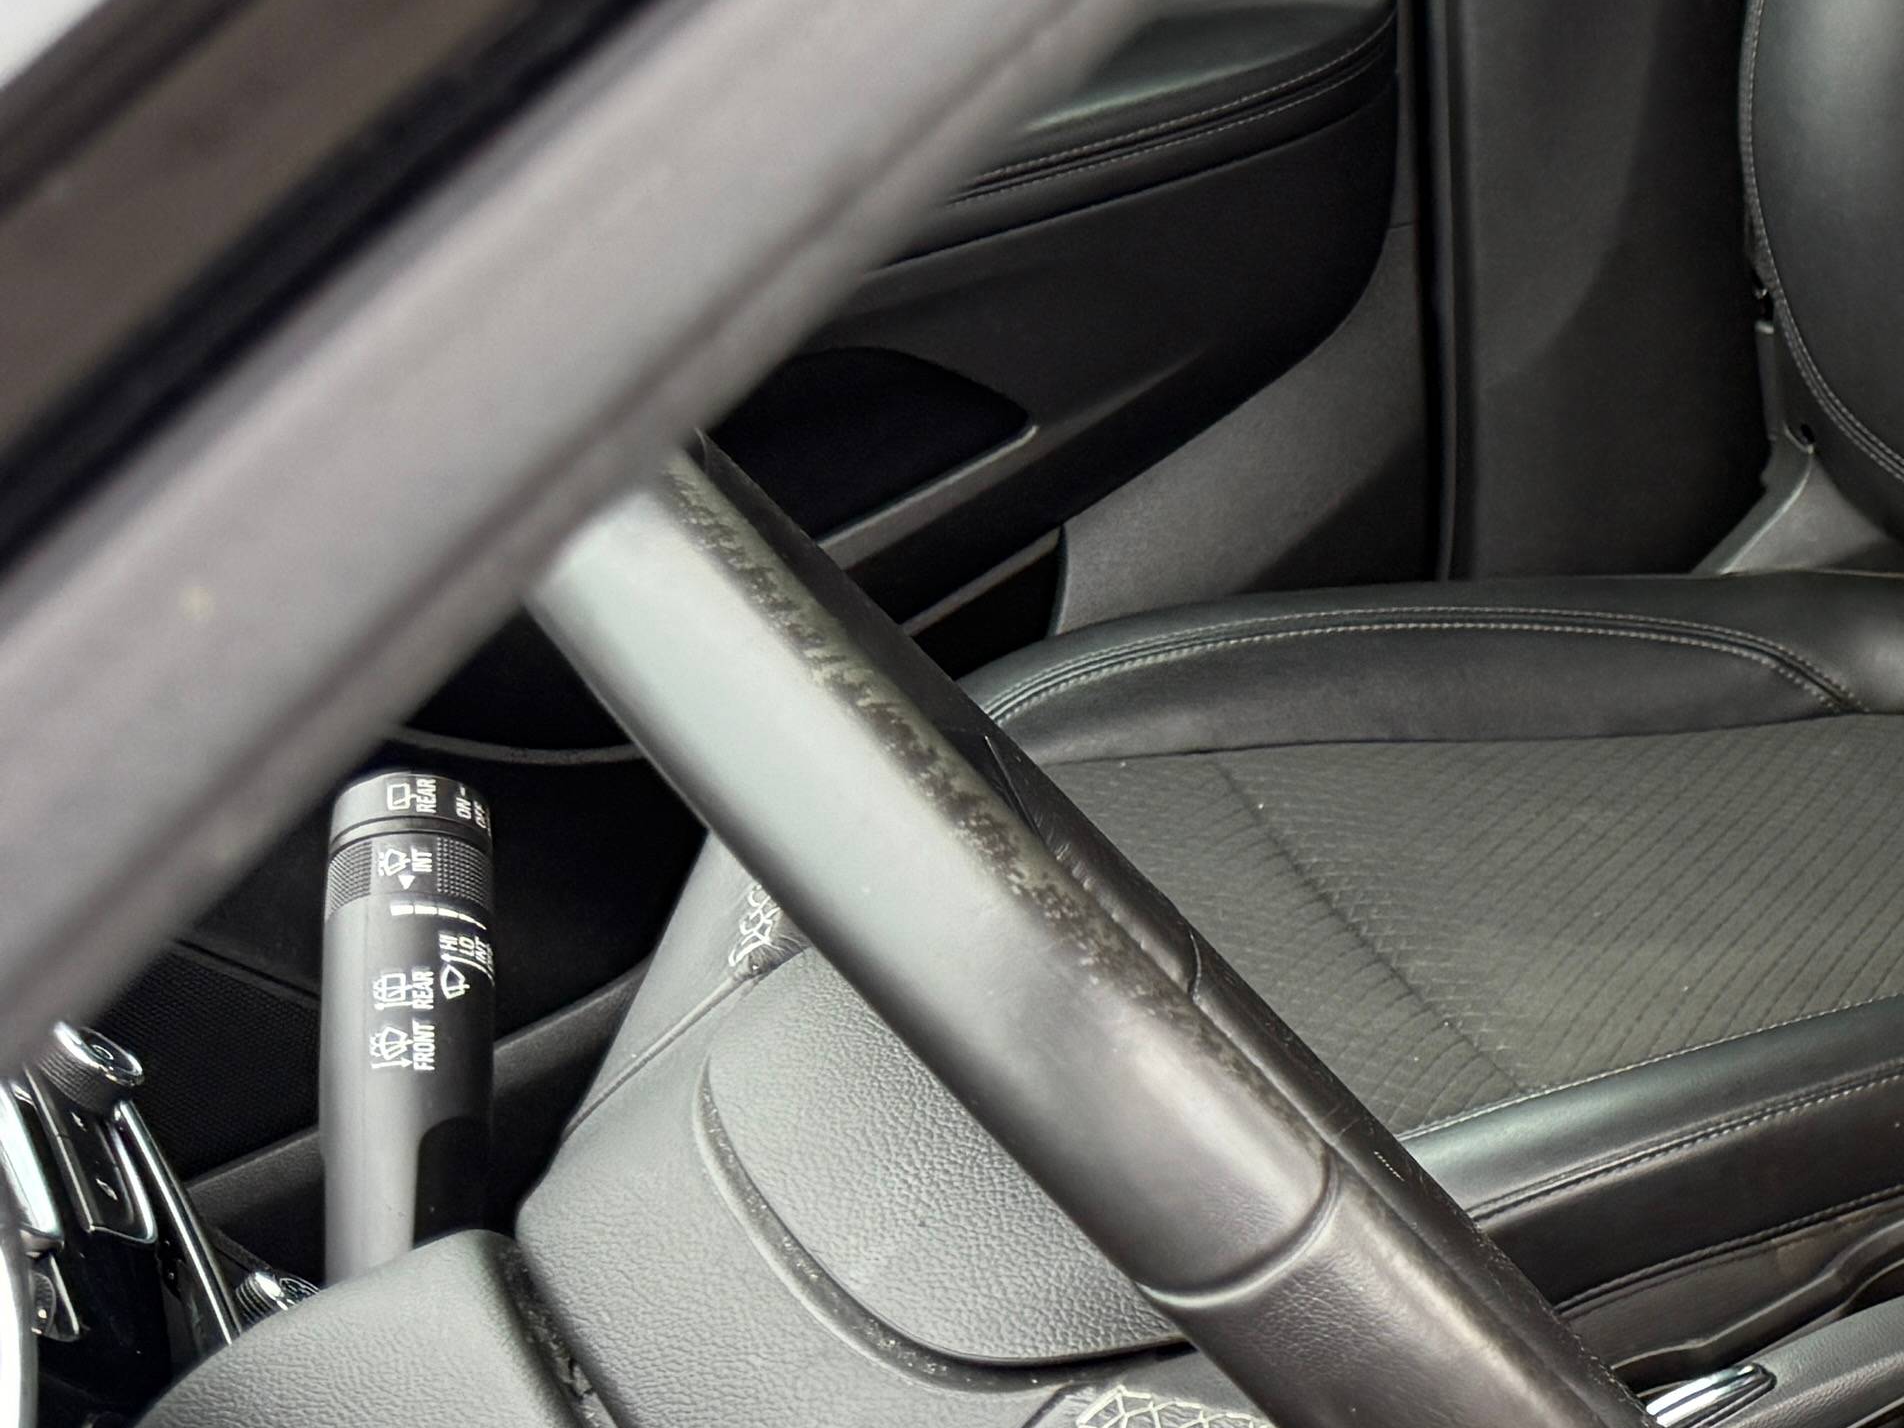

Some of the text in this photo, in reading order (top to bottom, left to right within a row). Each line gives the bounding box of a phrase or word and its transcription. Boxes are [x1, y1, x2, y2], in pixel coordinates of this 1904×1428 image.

[415, 777, 437, 813] REAR
[455, 797, 472, 819] ON
[410, 847, 433, 872] INT
[438, 933, 458, 951] HI
[458, 935, 475, 957] LO
[474, 935, 487, 964] INT
[411, 970, 434, 1010] REAR
[412, 1019, 435, 1071] FRONT
